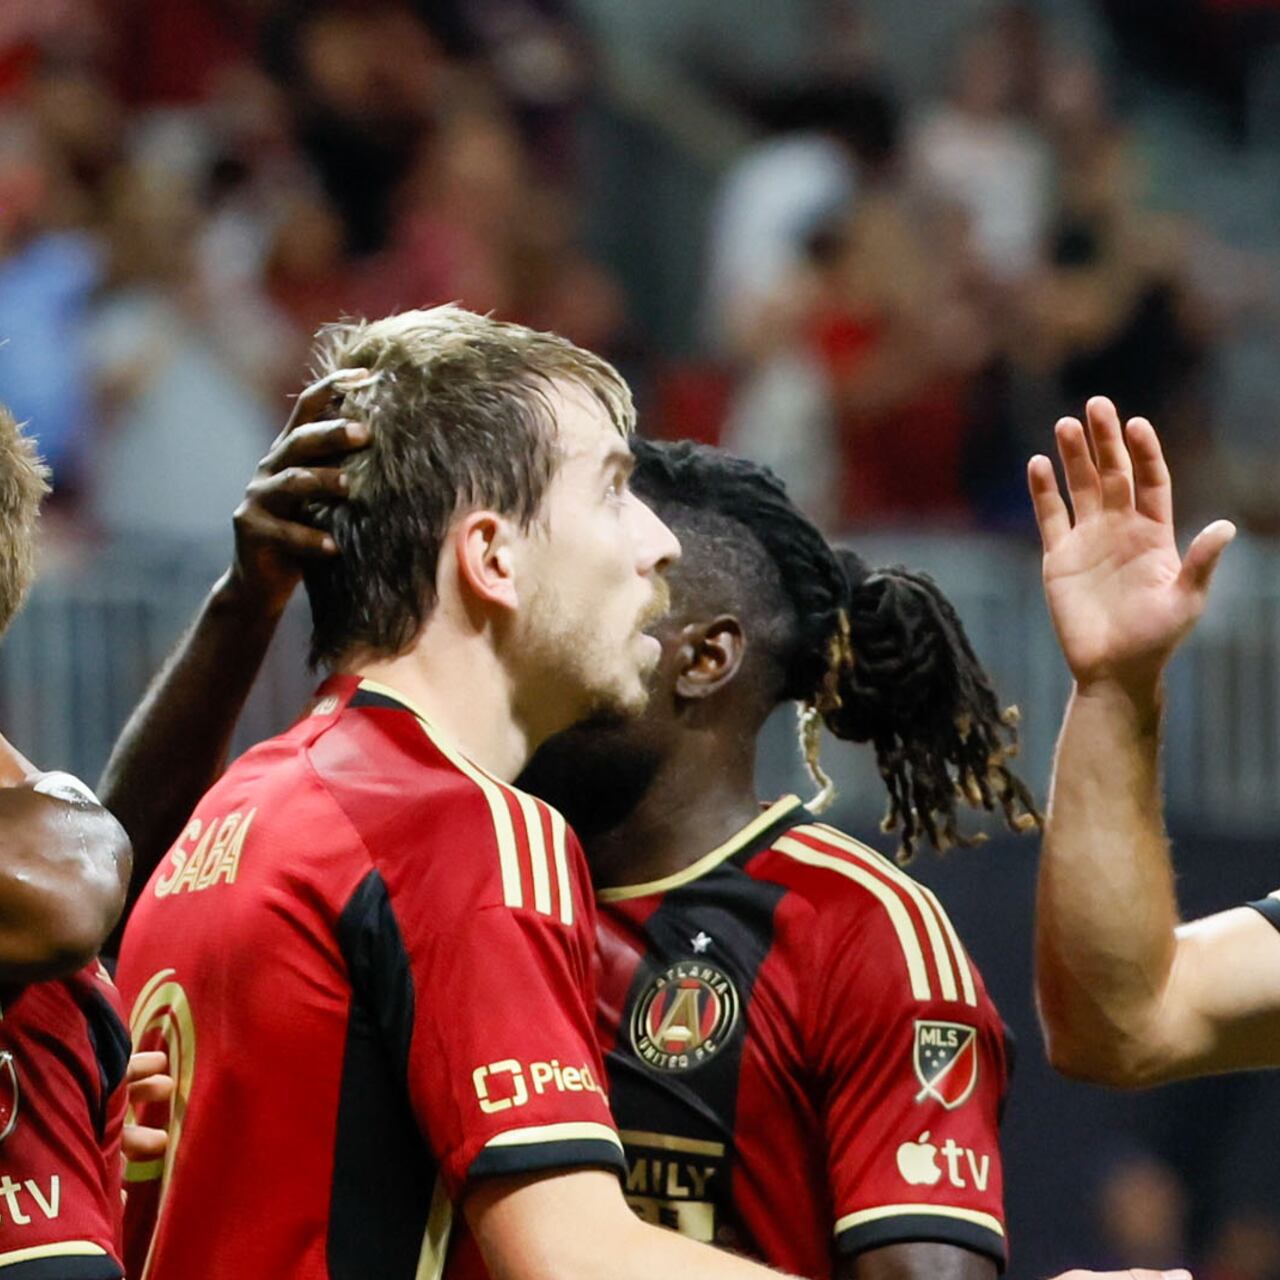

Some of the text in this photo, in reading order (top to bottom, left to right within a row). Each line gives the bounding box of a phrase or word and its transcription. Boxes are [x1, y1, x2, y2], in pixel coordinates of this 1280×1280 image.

[154, 806, 257, 898] SABA
[656, 966, 728, 994] ATLANTA
[639, 1037, 689, 1068] UNITED
[920, 1028, 959, 1048] MLS
[941, 1138, 990, 1192] tv
